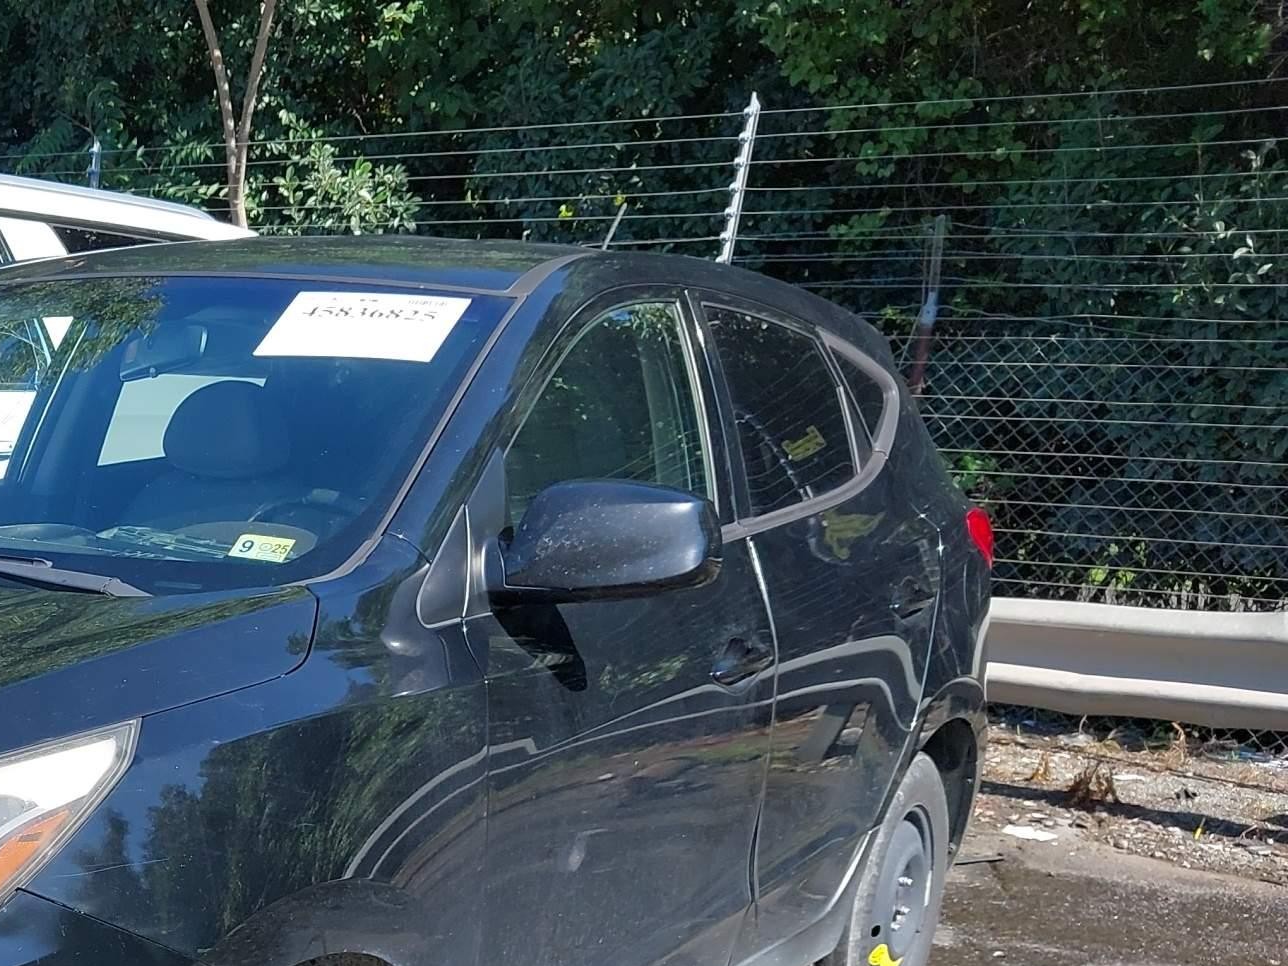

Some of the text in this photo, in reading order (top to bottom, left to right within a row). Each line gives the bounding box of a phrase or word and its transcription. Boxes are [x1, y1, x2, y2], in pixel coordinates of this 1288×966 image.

[302, 305, 438, 322] 45836825
[239, 539, 290, 555] 9 25
